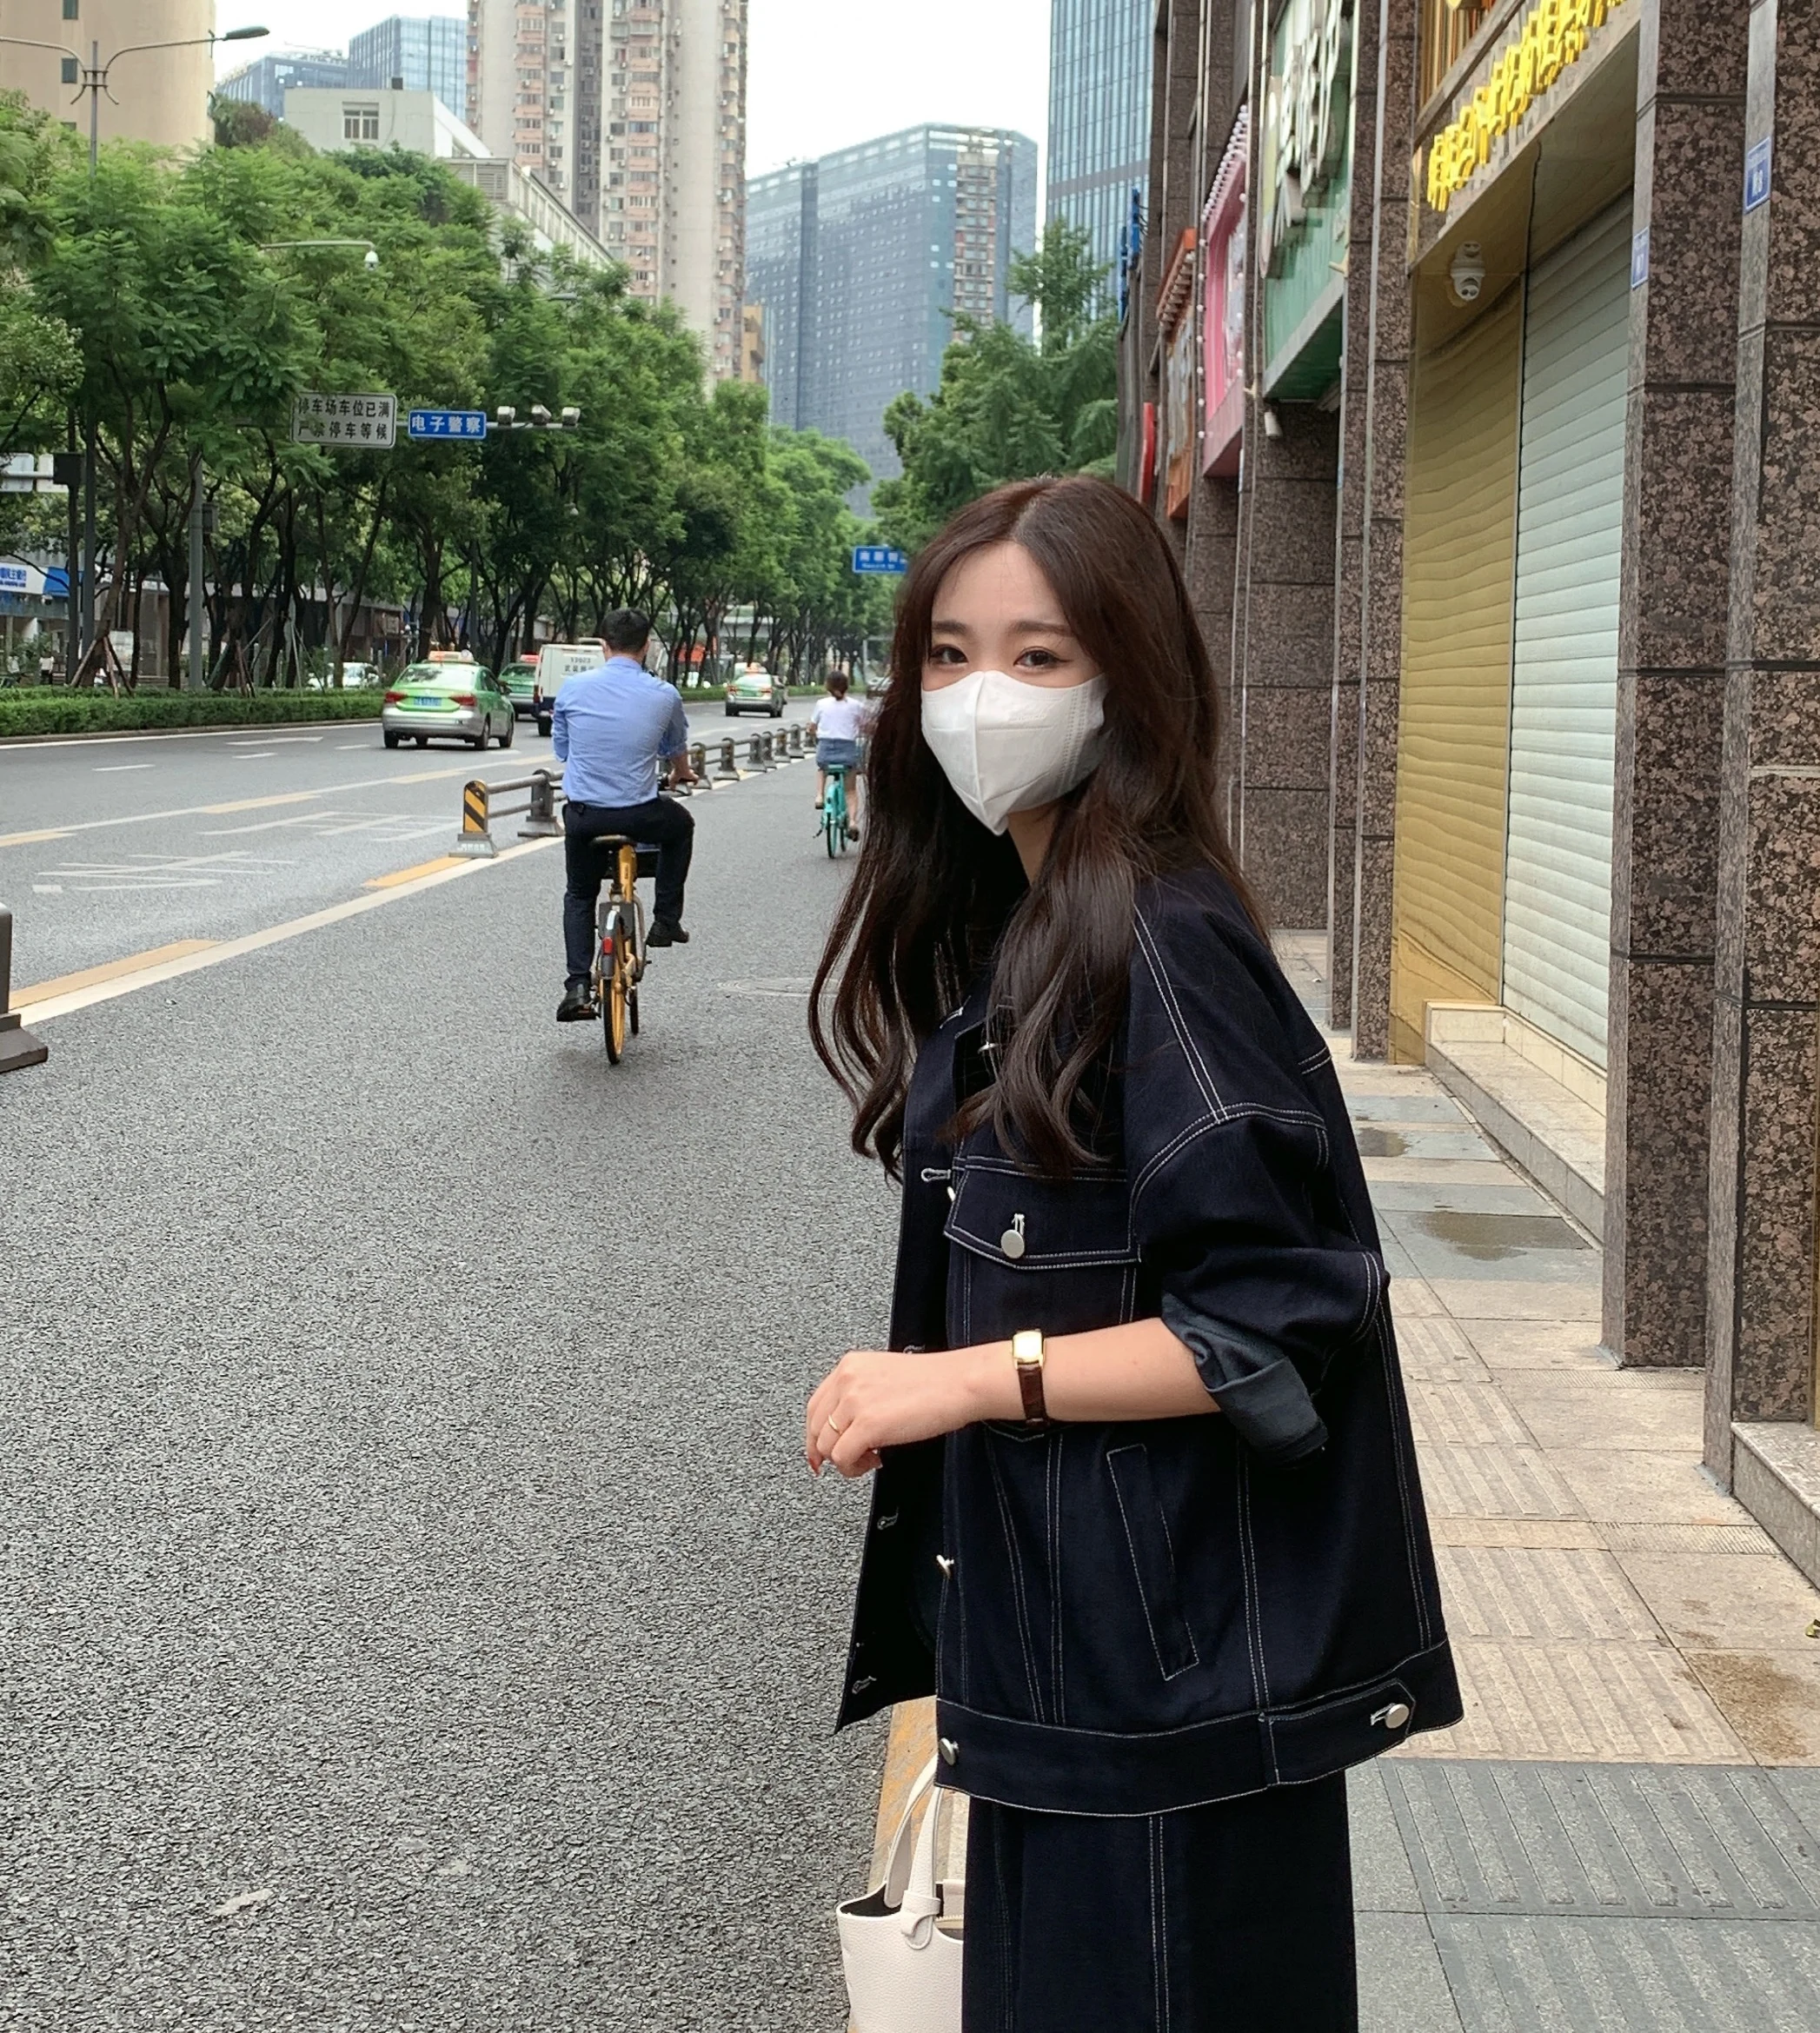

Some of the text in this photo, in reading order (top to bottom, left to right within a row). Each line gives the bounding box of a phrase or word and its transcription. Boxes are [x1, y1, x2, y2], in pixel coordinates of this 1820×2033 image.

[298, 397, 389, 417] 停车场车位已满
[411, 415, 480, 433] 电子警察
